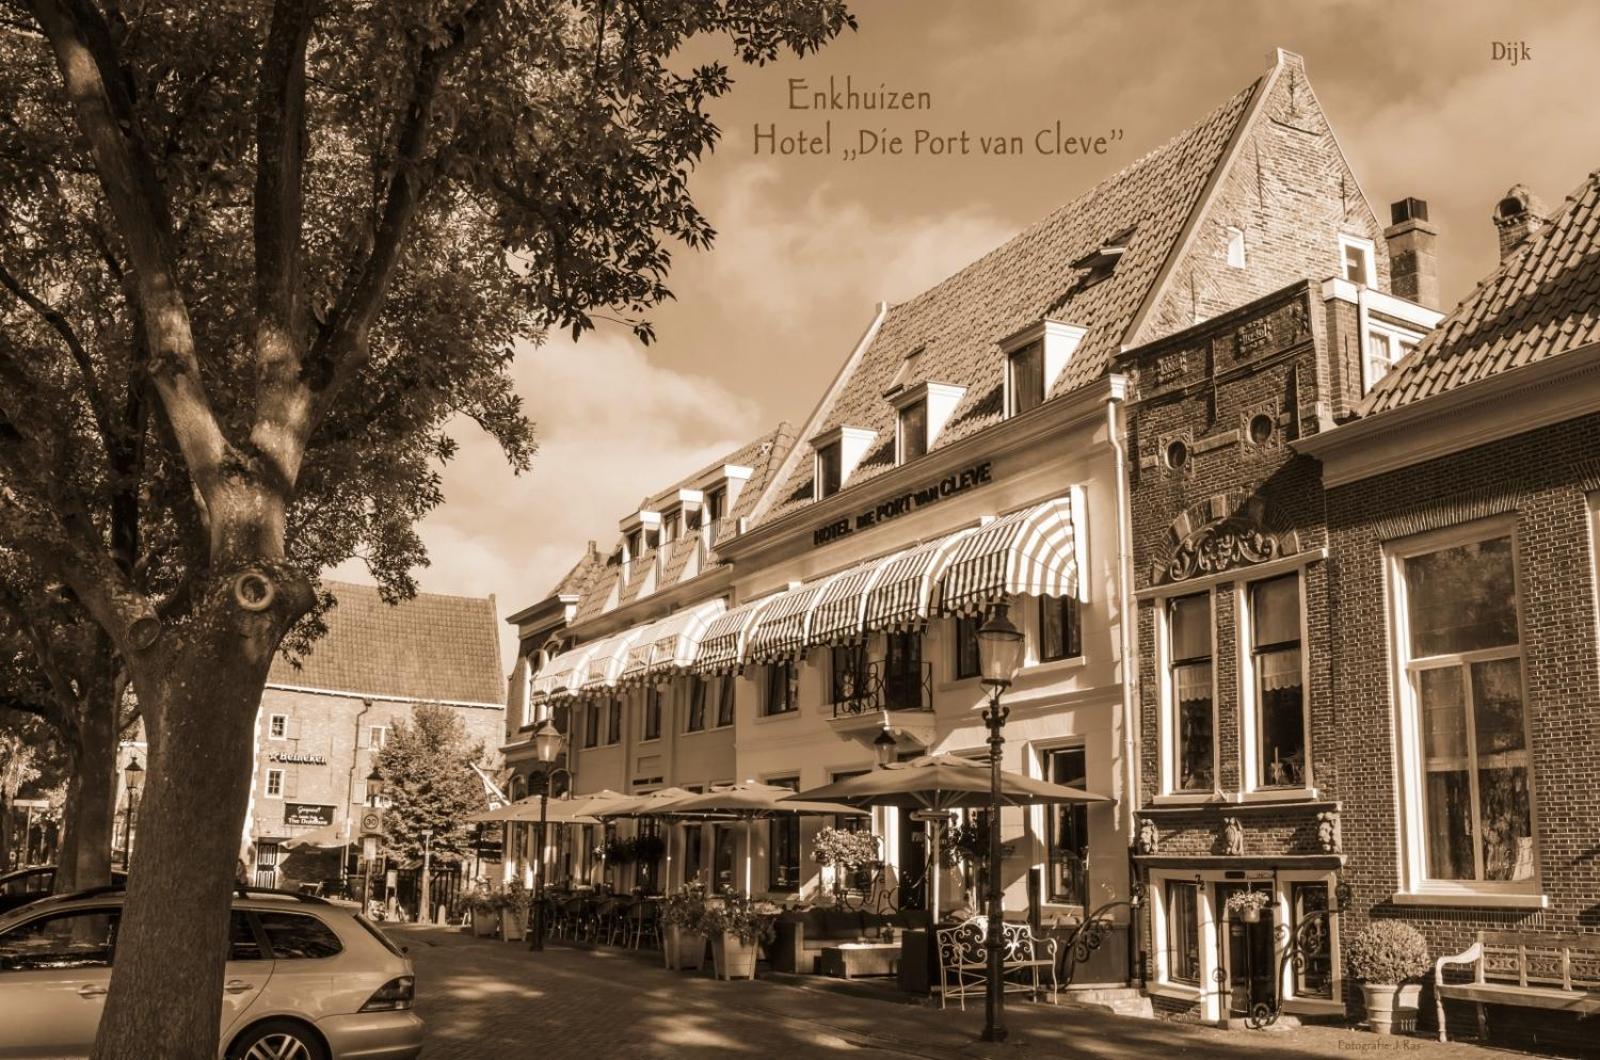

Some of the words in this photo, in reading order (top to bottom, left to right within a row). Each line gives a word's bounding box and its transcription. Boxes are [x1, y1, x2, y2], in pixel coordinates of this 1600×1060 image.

[814, 518, 853, 545] HOTEL
[877, 493, 912, 521] PORT
[914, 485, 939, 506] VAN
[940, 461, 992, 496] CLEVE
